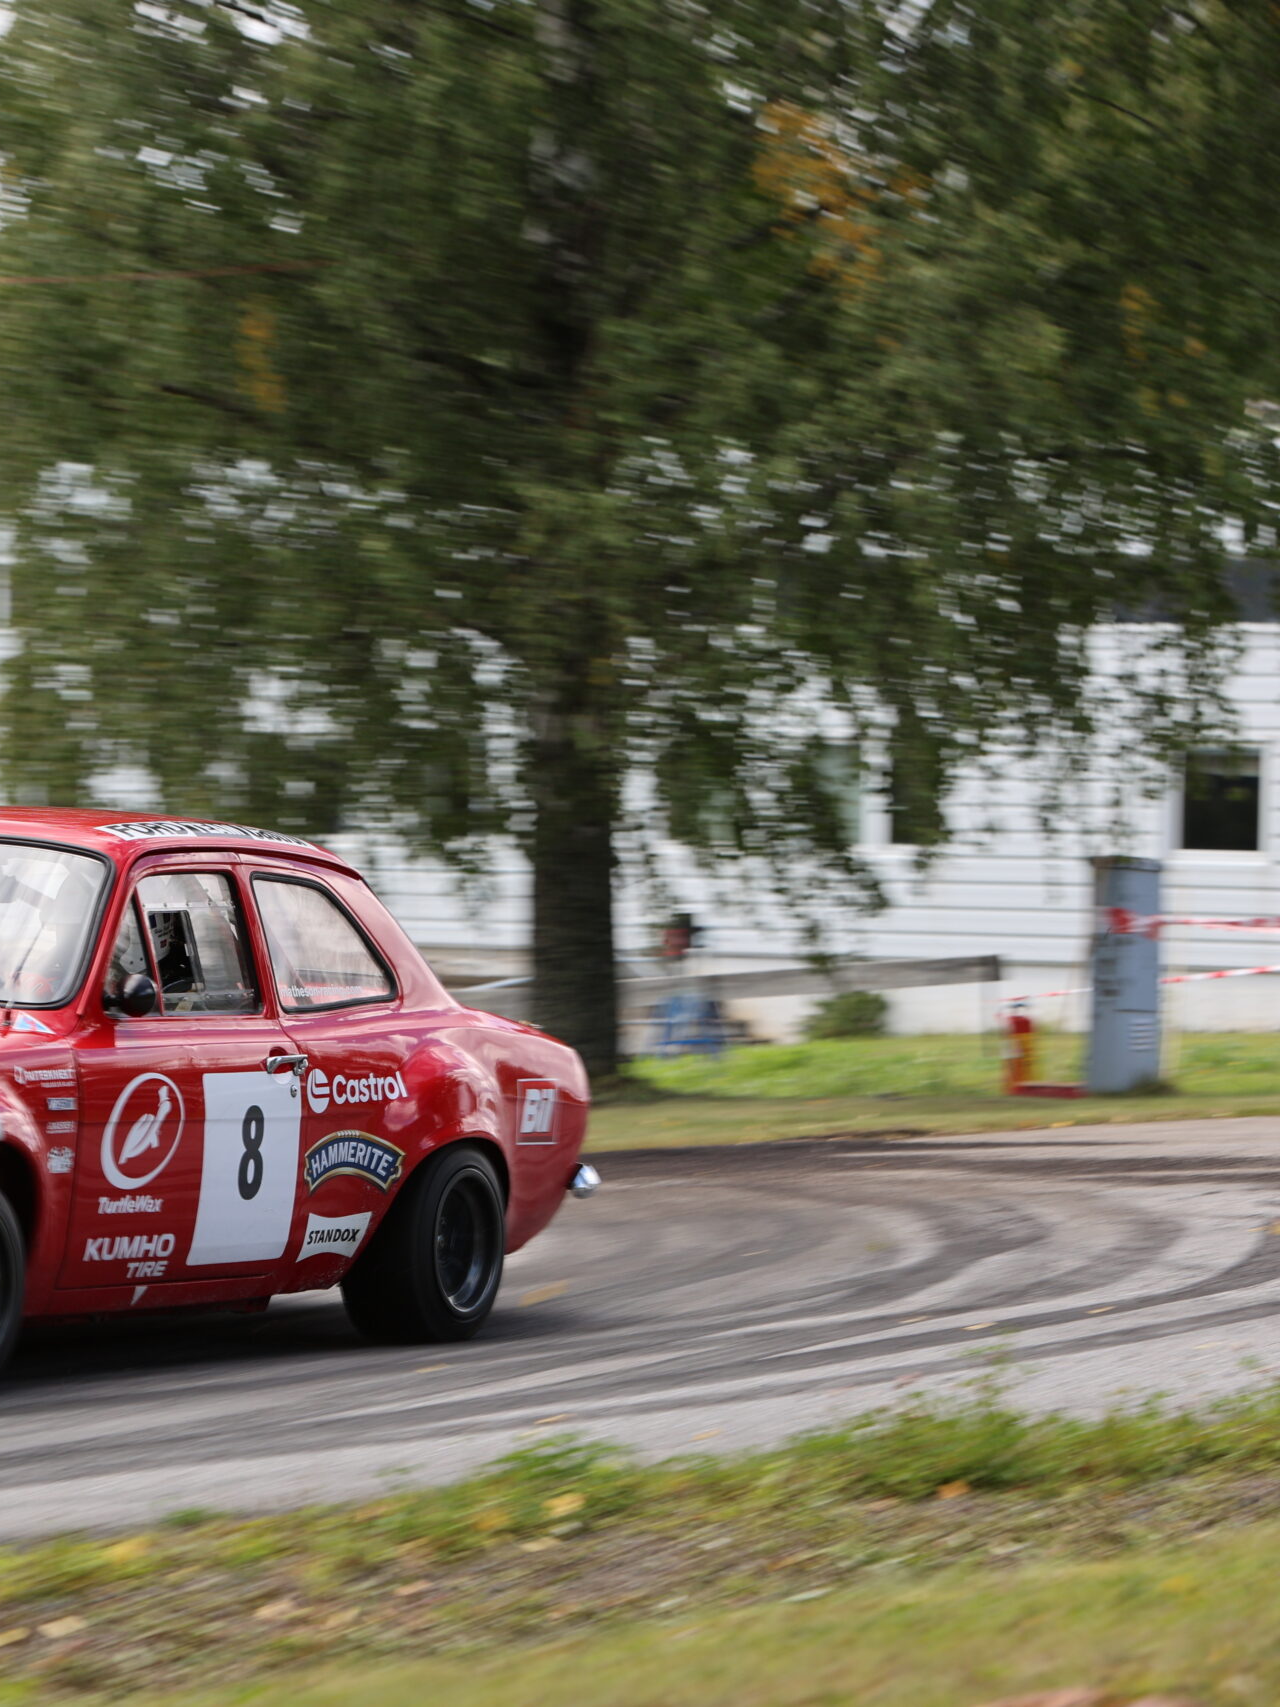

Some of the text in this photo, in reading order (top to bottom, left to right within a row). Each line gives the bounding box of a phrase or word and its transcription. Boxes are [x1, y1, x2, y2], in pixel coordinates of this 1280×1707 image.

[333, 1071, 407, 1104] Castrol
[238, 1105, 265, 1200] 8
[311, 1142, 392, 1176] HAMMERITE
[97, 1194, 163, 1214] TurtleWax
[82, 1233, 176, 1262] KUMHO
[306, 1229, 360, 1245] STANDOX
[126, 1261, 169, 1278] TIRE
